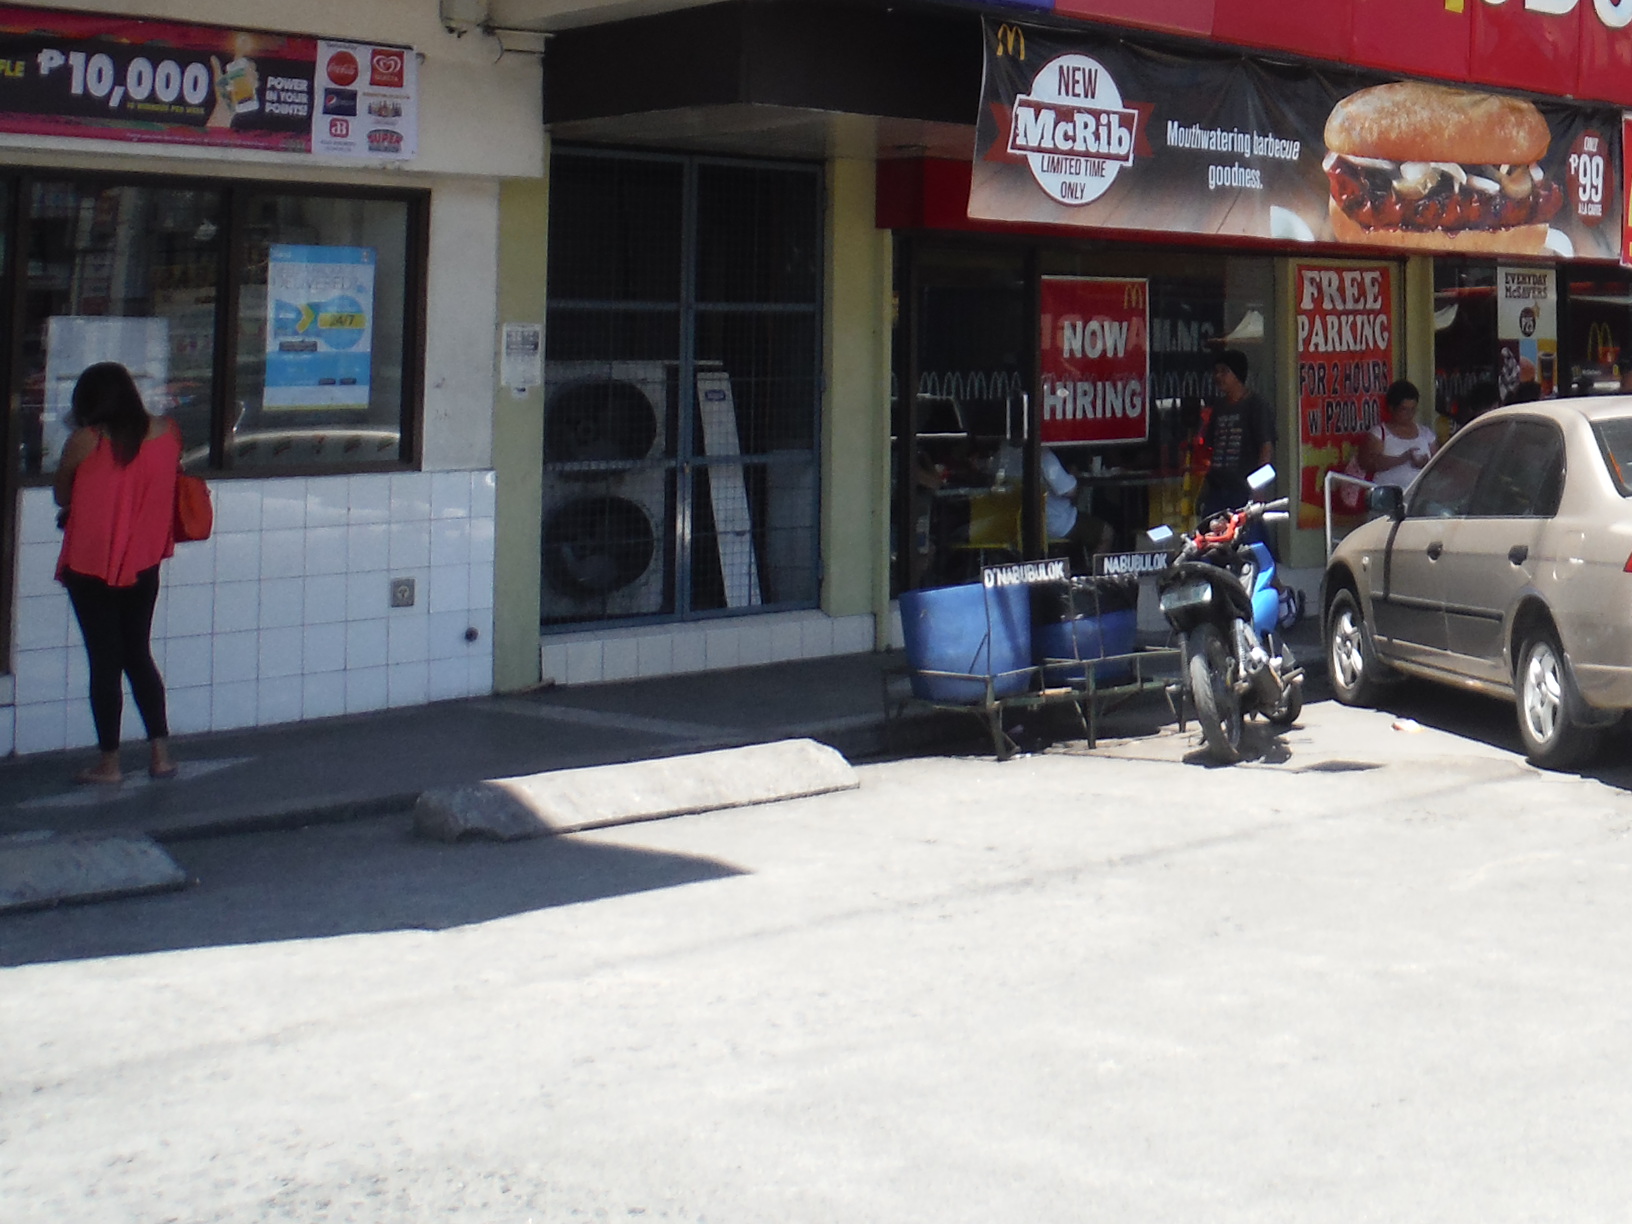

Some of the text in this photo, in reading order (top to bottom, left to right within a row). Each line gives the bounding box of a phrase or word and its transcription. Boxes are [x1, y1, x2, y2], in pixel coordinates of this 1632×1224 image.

[265, 91, 308, 104] IN YOUR
[266, 76, 309, 92] POWER
[1058, 64, 1099, 100] NEW
[1016, 106, 1131, 156] McRib
[1166, 120, 1300, 161] Mouthwatering barbecue
[1041, 155, 1106, 178] LIMITED TIME
[1208, 162, 1264, 190] goodness.
[1060, 181, 1087, 201] ONLY
[1300, 269, 1383, 311] FREE
[1504, 272, 1548, 286] EVERYDAY
[1063, 319, 1128, 359] NOW
[1297, 313, 1390, 353] PARKING
[1299, 359, 1389, 396] FOR 2 HOURS
[1043, 379, 1143, 420] HIRING
[984, 561, 1065, 588] D'NABUBULOK
[1103, 553, 1168, 575] NABUBULOK
